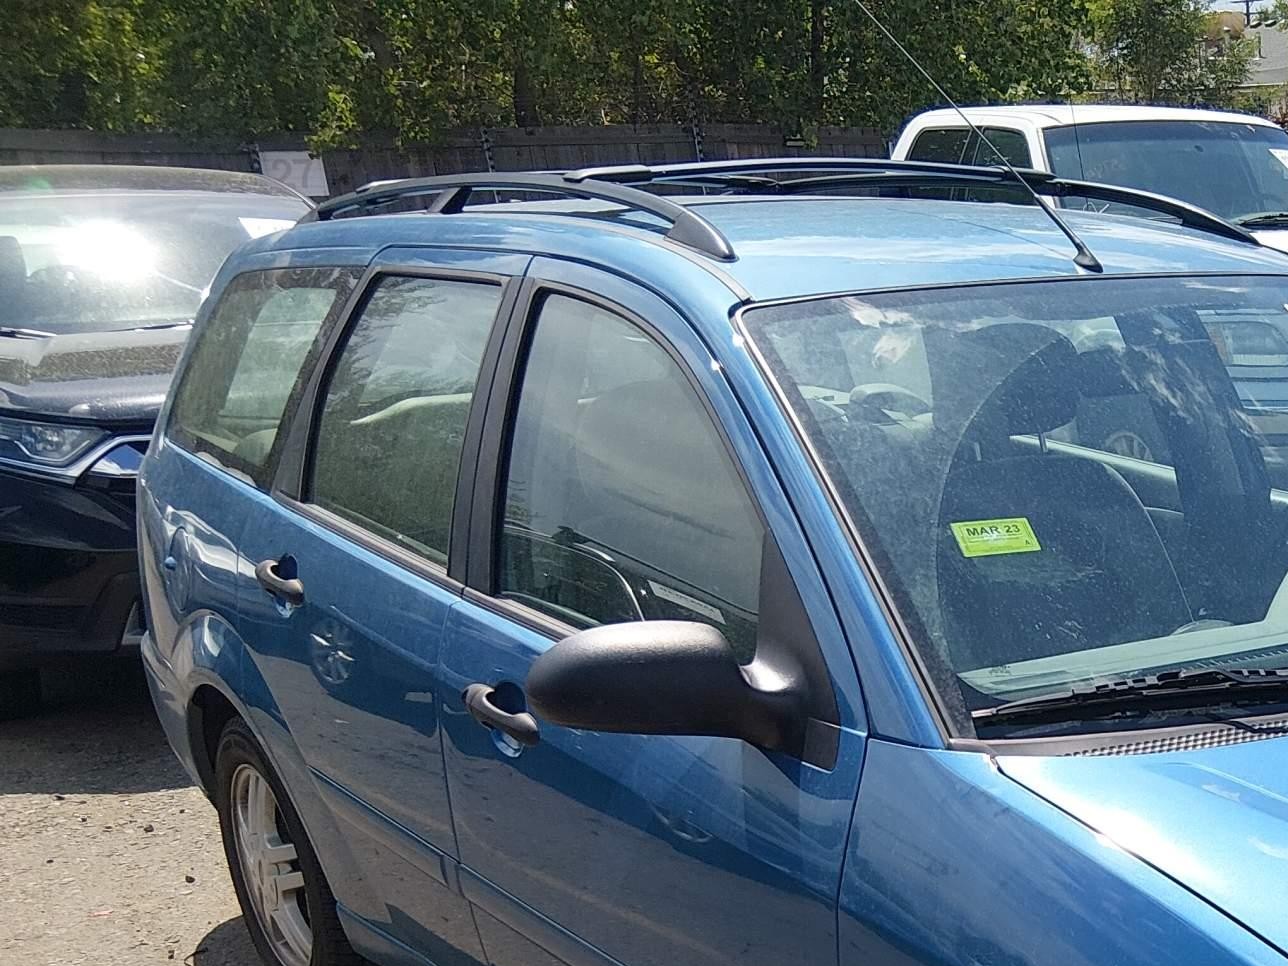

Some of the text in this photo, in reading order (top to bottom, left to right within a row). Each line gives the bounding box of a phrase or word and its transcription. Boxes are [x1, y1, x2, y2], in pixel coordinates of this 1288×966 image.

[271, 159, 312, 188] 27
[966, 524, 1021, 537] MAR 23
